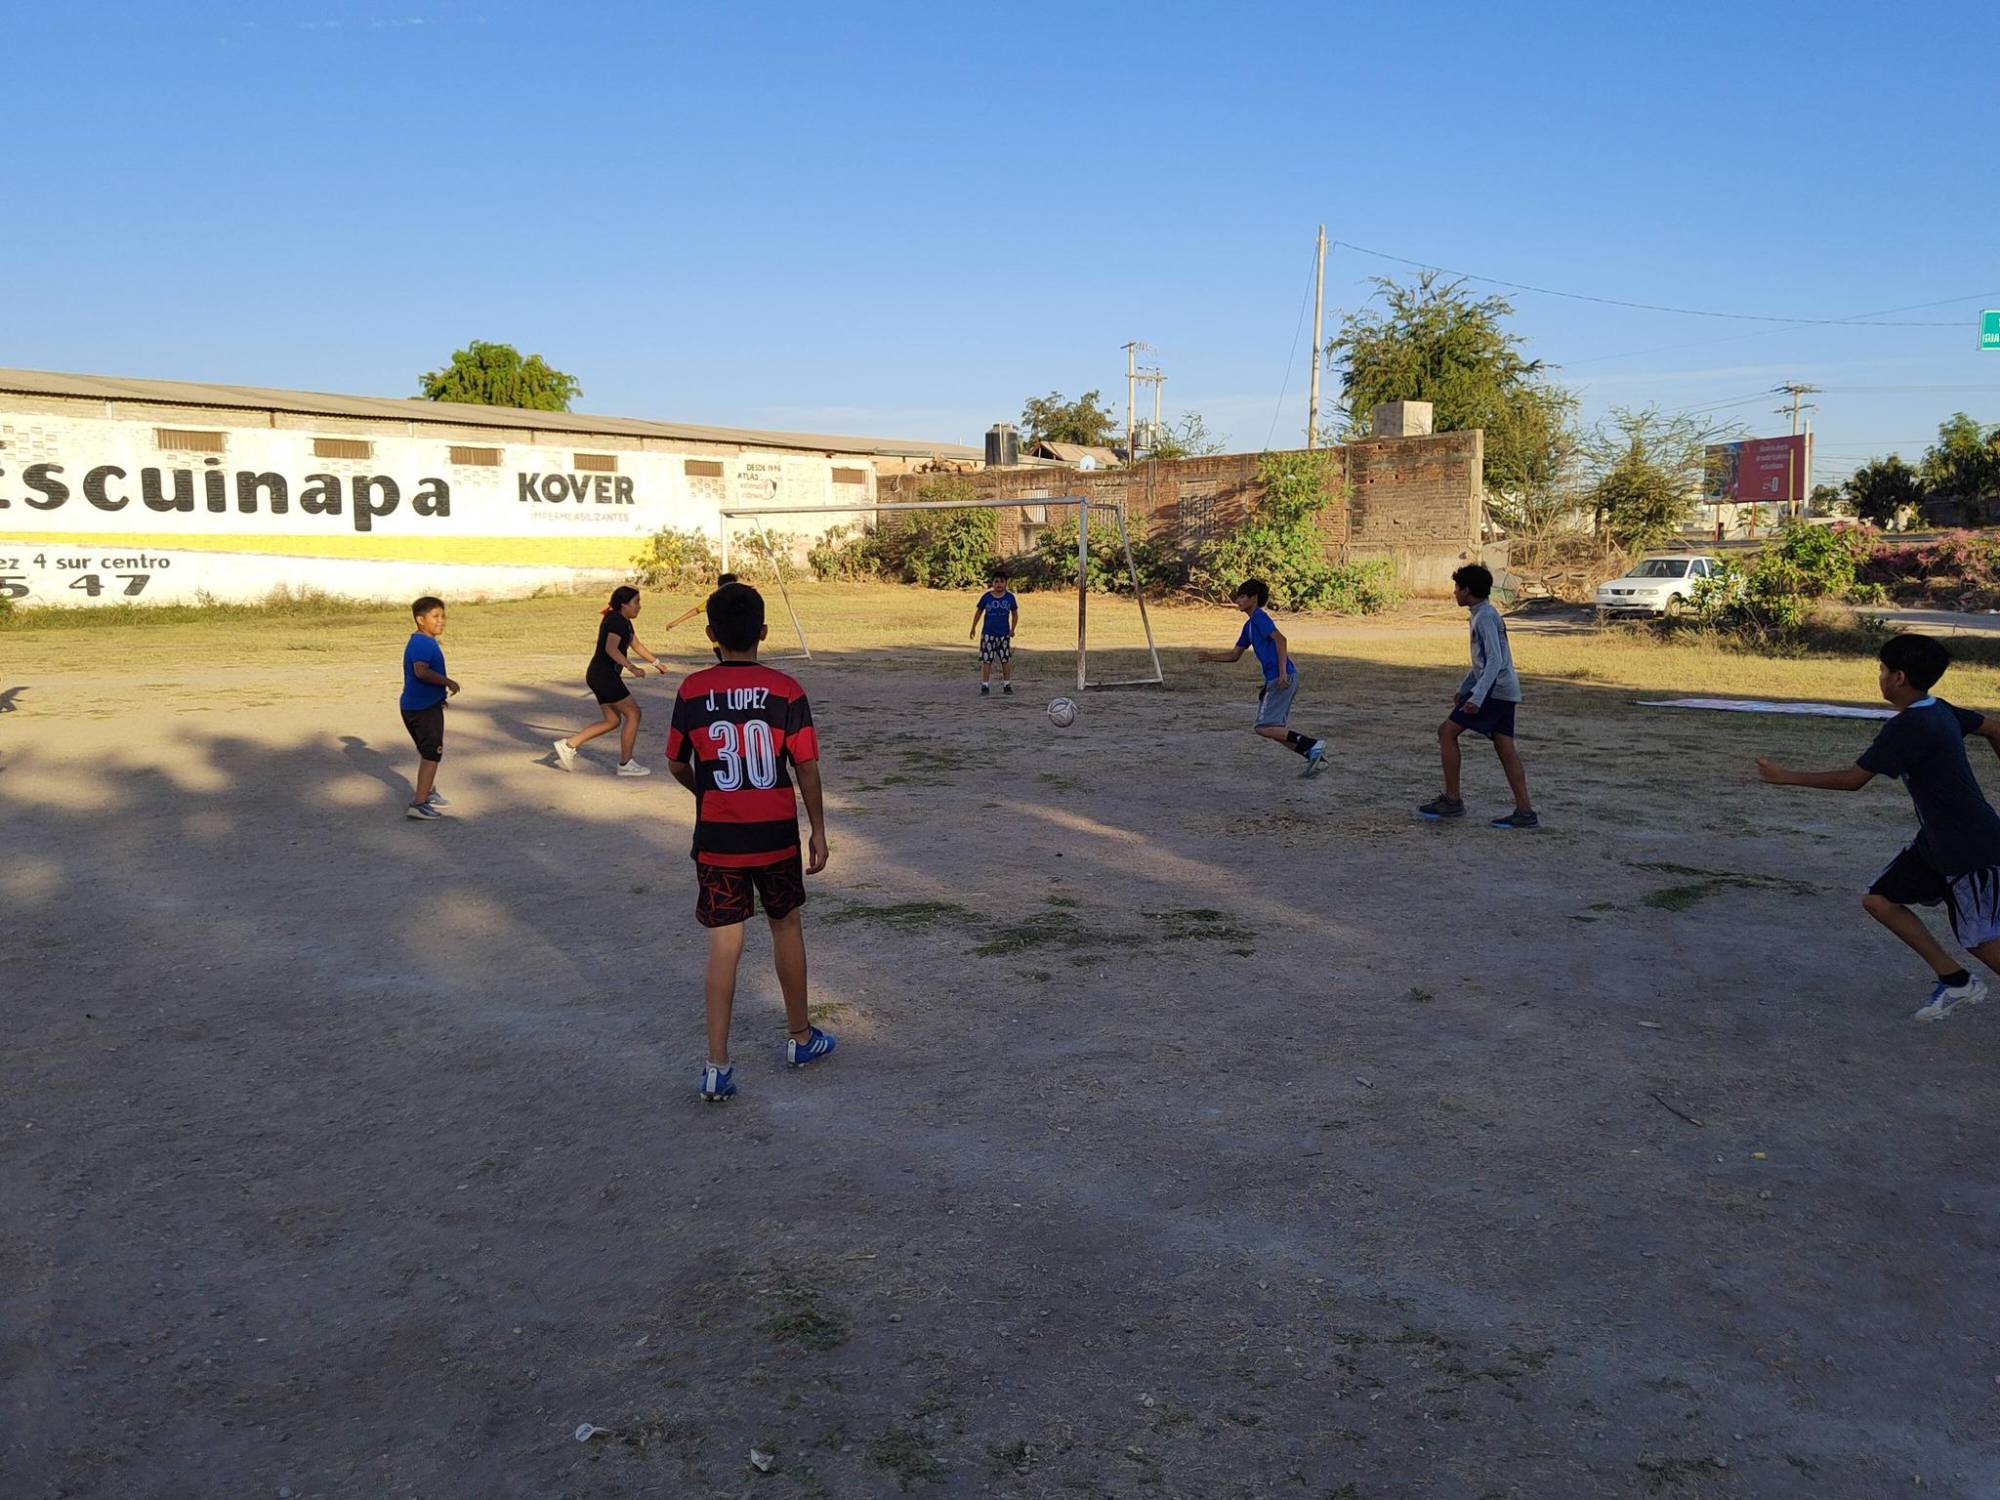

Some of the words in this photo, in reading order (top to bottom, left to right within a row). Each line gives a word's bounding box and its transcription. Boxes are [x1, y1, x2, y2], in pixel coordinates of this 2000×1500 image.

[0, 457, 451, 532] scuinapa
[518, 472, 635, 505] KOVER
[33, 553, 47, 569] 4
[56, 558, 92, 569] sur
[101, 553, 171, 569] centro
[706, 689, 720, 712] J.
[727, 686, 770, 711] LOPEZ
[708, 719, 778, 792] 30
